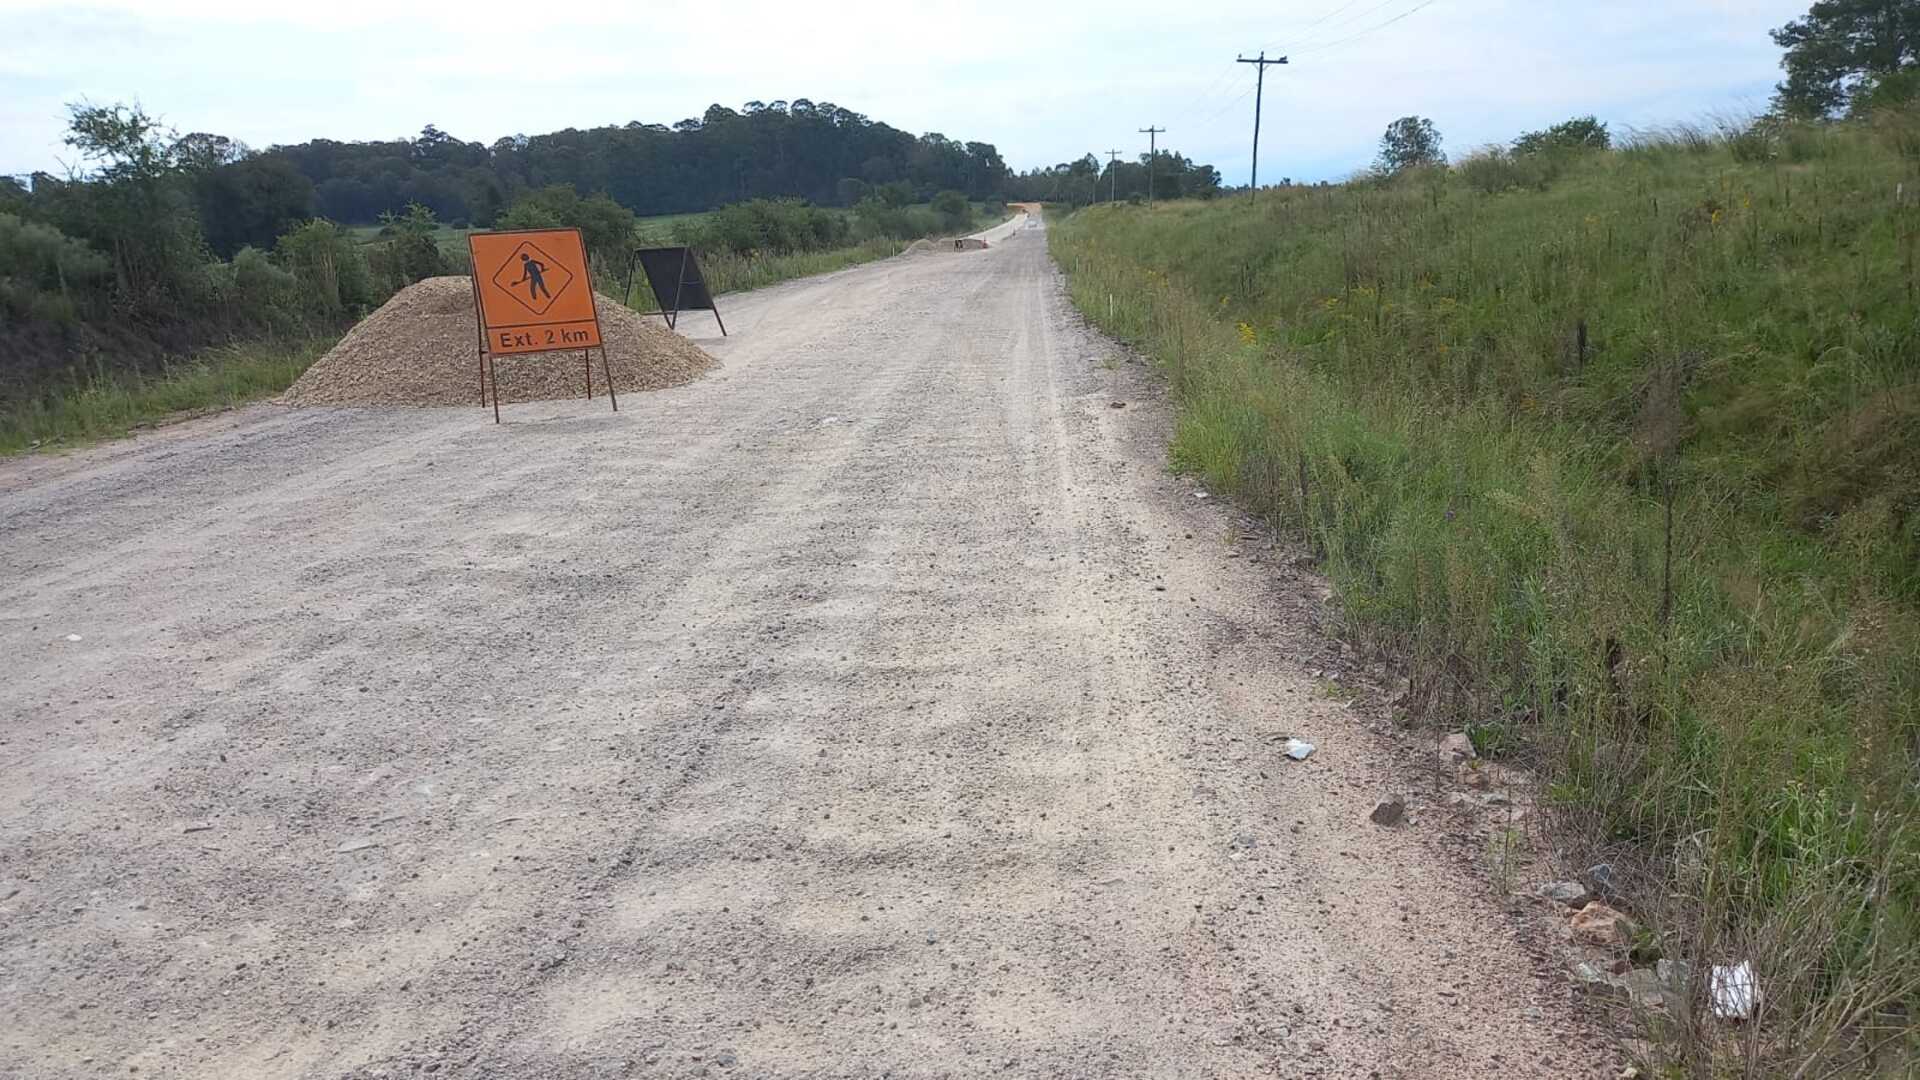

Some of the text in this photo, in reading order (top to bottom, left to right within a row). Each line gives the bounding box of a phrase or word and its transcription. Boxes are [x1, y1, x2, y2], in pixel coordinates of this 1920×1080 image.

[500, 328, 589, 348] Ext. 2 km
